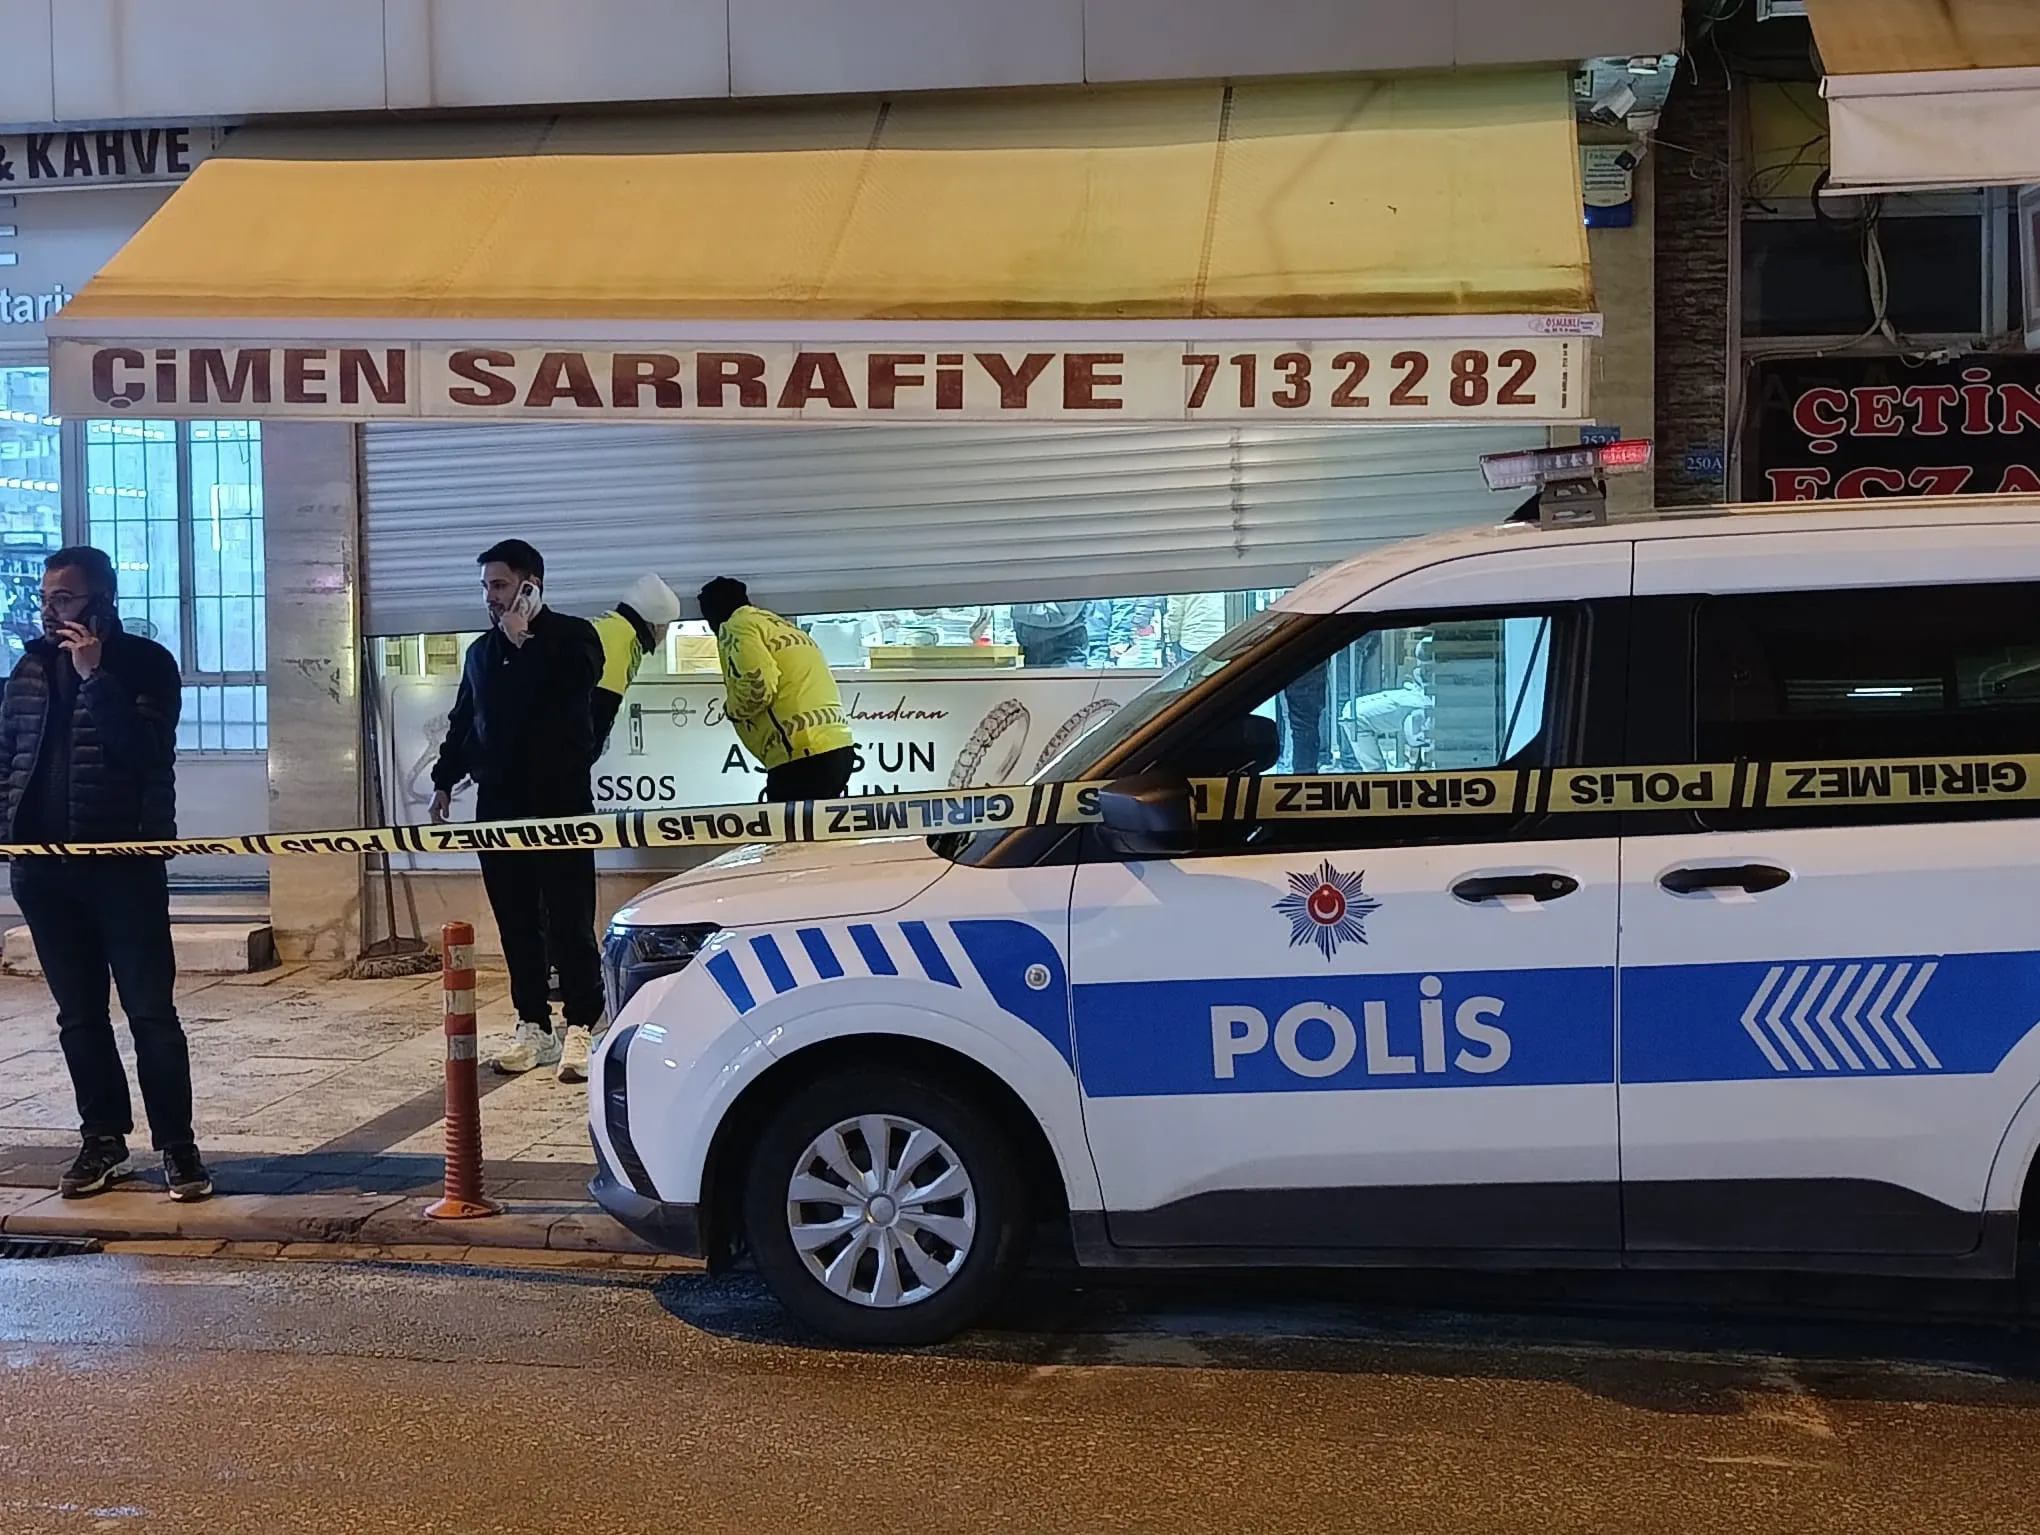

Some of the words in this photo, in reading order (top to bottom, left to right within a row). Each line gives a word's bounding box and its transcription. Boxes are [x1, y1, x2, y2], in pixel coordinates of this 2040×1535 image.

[27, 127, 190, 179] KAHVE
[1686, 457, 1723, 470] 250A
[593, 775, 677, 801] SSOS
[1210, 974, 1513, 1080] POLİS
